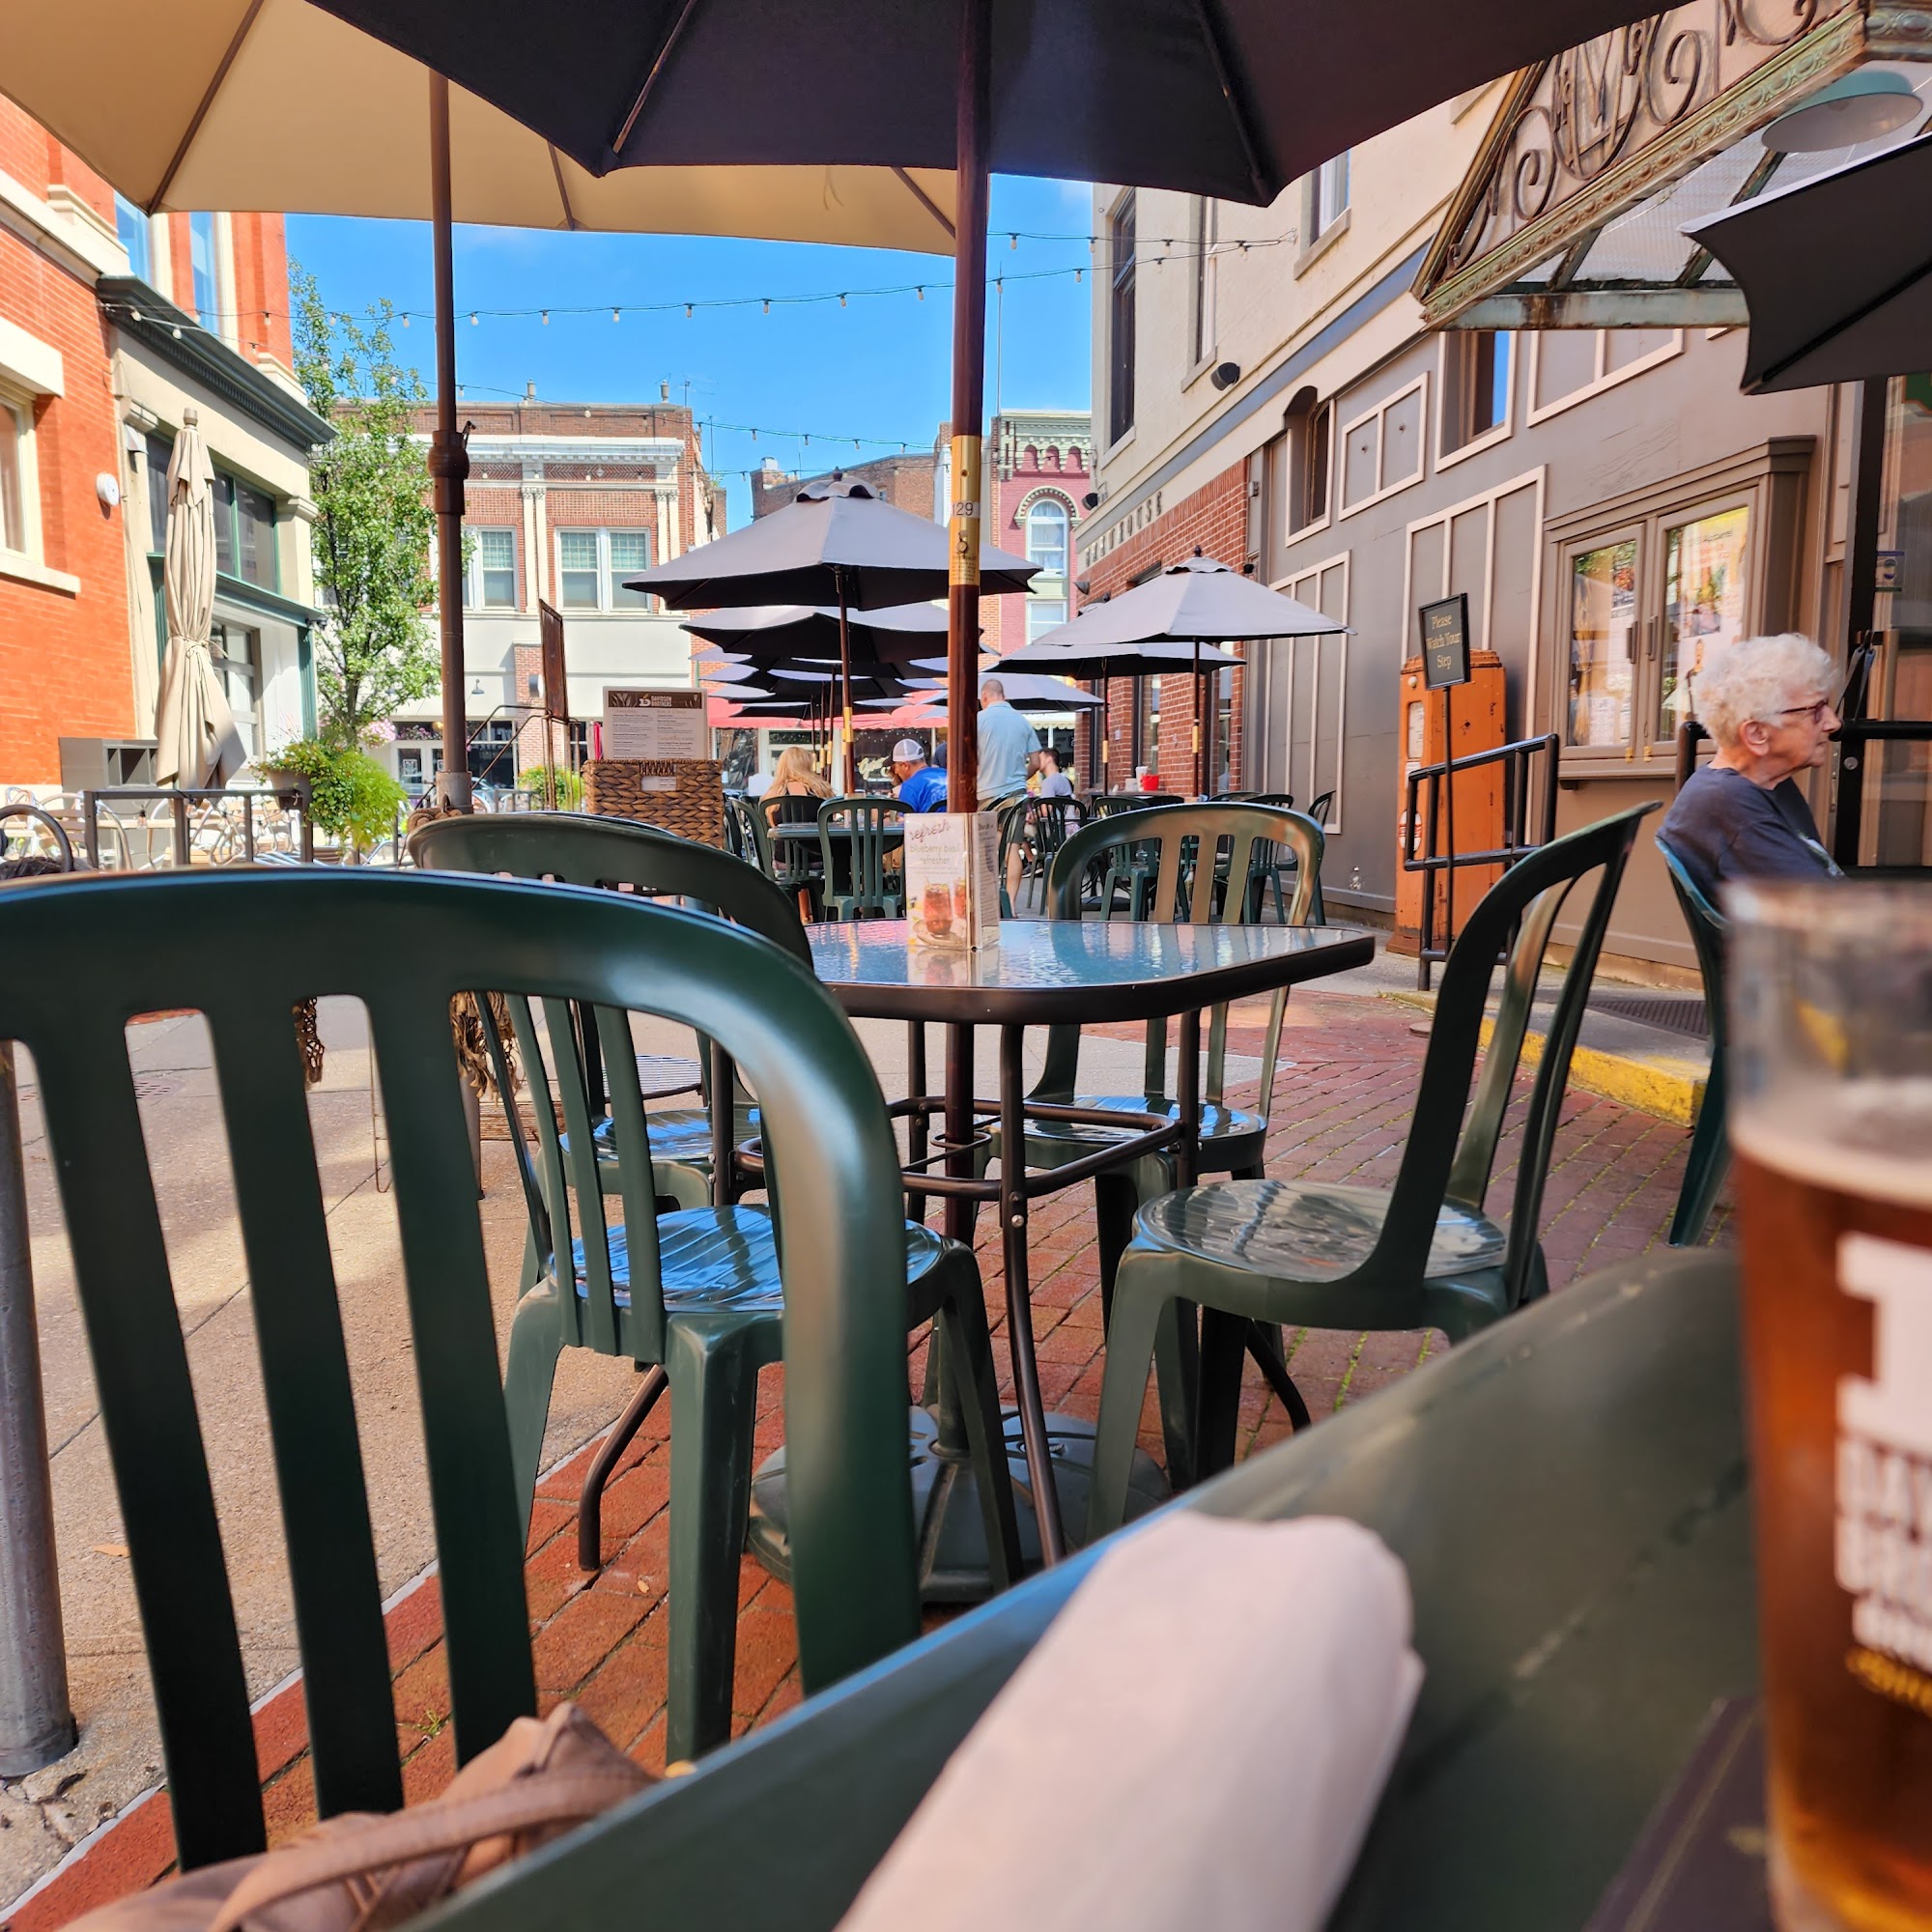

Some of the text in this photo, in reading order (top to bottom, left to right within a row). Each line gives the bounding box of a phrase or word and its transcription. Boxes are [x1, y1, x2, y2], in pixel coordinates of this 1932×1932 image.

[1432, 614, 1452, 629] Please
[1427, 633, 1461, 650] Watch Your
[1437, 655, 1452, 669] Step
[910, 819, 951, 842] refresh
[910, 844, 943, 856] blueberry
